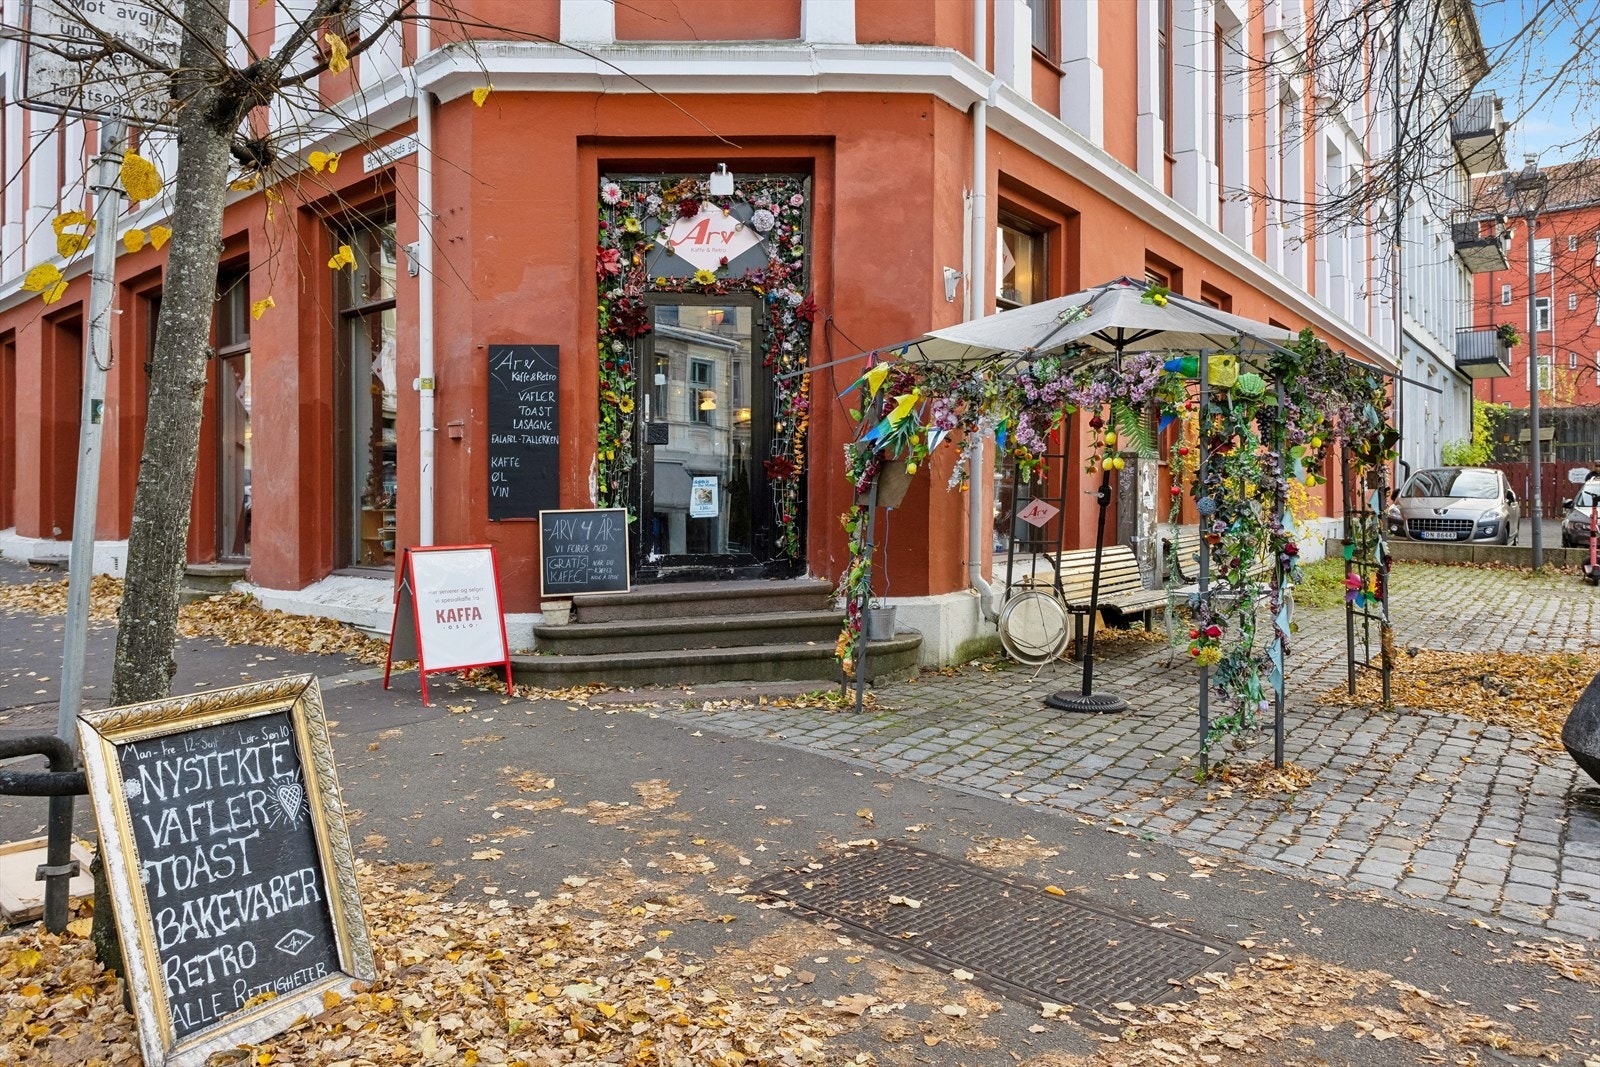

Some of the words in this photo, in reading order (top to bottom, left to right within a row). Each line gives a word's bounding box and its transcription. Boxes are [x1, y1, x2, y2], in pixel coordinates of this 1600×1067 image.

[670, 218, 734, 246] Arv
[494, 350, 536, 370] Arv
[518, 391, 556, 402] VAFLER
[518, 406, 553, 416] TOAST
[513, 419, 552, 430] LASAGNE
[491, 457, 520, 468] KAFFE
[491, 471, 508, 482] ØL
[491, 486, 509, 498] VIN
[1023, 506, 1047, 518] Arv
[548, 518, 577, 540] ARV
[581, 520, 592, 540] 4
[595, 514, 616, 542] ÅR
[555, 545, 564, 553] VI
[548, 556, 586, 569] GRATIS
[550, 570, 582, 582] KAFFE
[436, 607, 482, 624] KAFFA
[161, 740, 176, 756] Fre
[261, 727, 280, 741] Søn
[138, 740, 294, 804] NYSTEKTE
[143, 789, 270, 848] VAFLER
[144, 829, 260, 897] TOAST
[155, 868, 321, 951] BAKEVARER
[163, 940, 256, 998] RETRO
[170, 992, 226, 1030] ALLE
[233, 962, 328, 1008] RETTIGHETER
